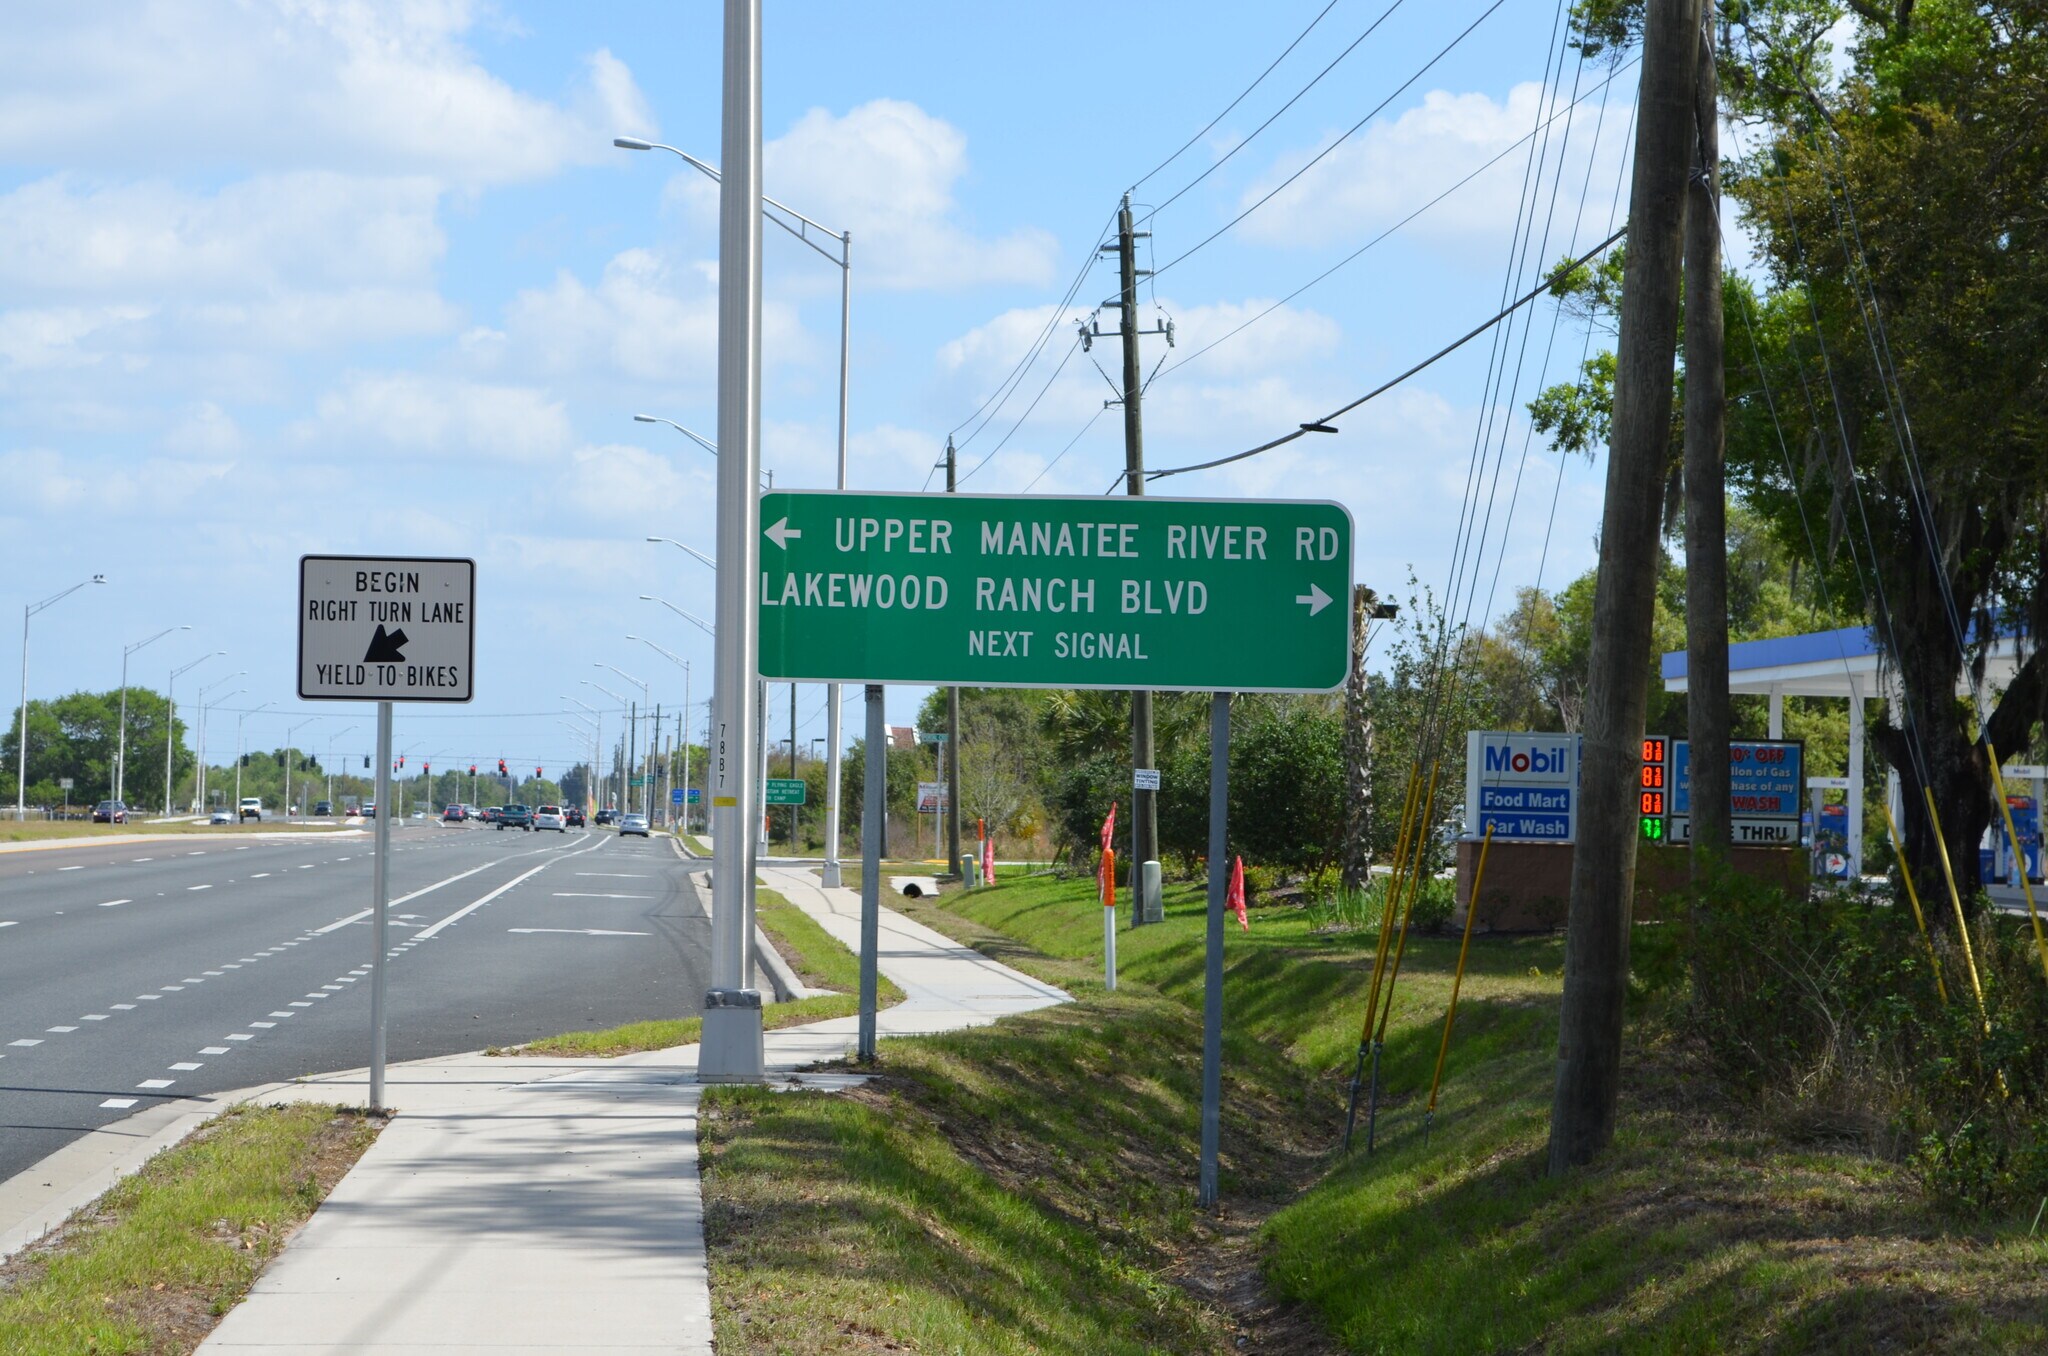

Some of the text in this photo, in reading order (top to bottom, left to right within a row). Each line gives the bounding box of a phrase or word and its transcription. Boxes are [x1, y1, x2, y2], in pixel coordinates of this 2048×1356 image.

[835, 517, 1339, 561] UPPER MANATEE RIVER RD
[355, 571, 419, 593] BEGIN
[761, 571, 1208, 615] LAKEWOOD RANCH BLVD
[309, 600, 464, 623] RIGHT TURN LANE
[969, 630, 1148, 659] NEXT SIGNAL
[316, 664, 458, 687] YIELD TO BIKES
[1485, 745, 1565, 773] Mobil
[1755, 747, 1785, 764] OFF
[1756, 766, 1768, 777] of
[1770, 767, 1791, 778] Gas
[1760, 781, 1772, 791] of
[1775, 783, 1794, 793] any
[1484, 791, 1566, 808] Food Mart
[1731, 796, 1781, 811] WASH
[1519, 819, 1565, 835] Wash
[1740, 825, 1788, 840] THRU
